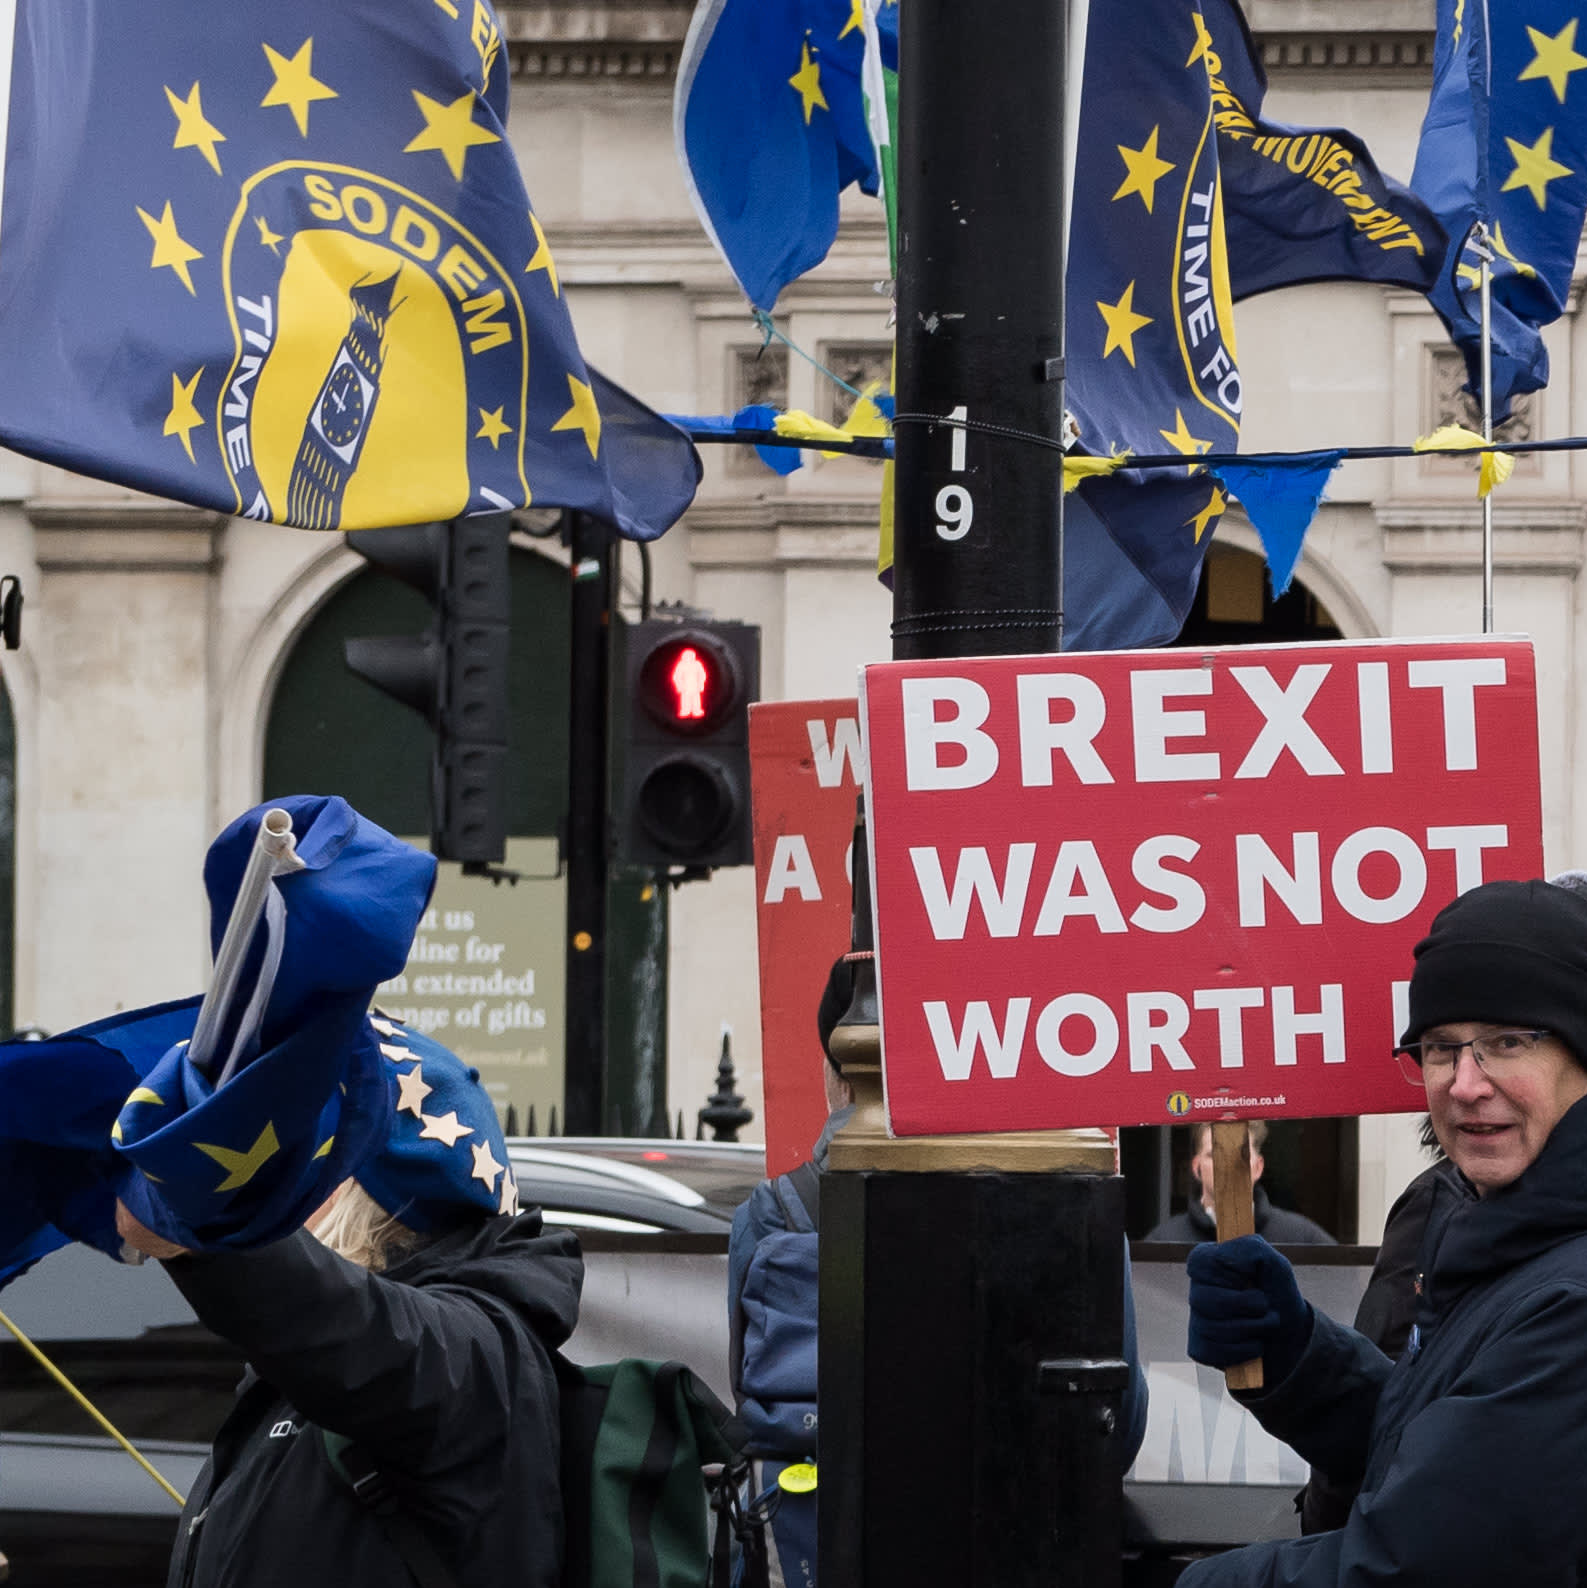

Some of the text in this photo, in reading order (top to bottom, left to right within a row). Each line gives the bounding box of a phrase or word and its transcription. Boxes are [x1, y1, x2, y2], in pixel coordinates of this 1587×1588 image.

[303, 174, 513, 355] SODEM
[1183, 181, 1216, 348] TIME
[224, 295, 273, 475] TIME
[901, 657, 1507, 792] BREXIT
[444, 911, 475, 931] us
[908, 824, 1509, 941] WAS NOT
[413, 968, 536, 996] extended
[465, 935, 505, 963] for
[454, 1000, 487, 1028] of
[487, 1001, 547, 1036] gifts
[922, 983, 1346, 1081] WORTH
[1194, 1094, 1287, 1109] SODEMaction.co.uk
